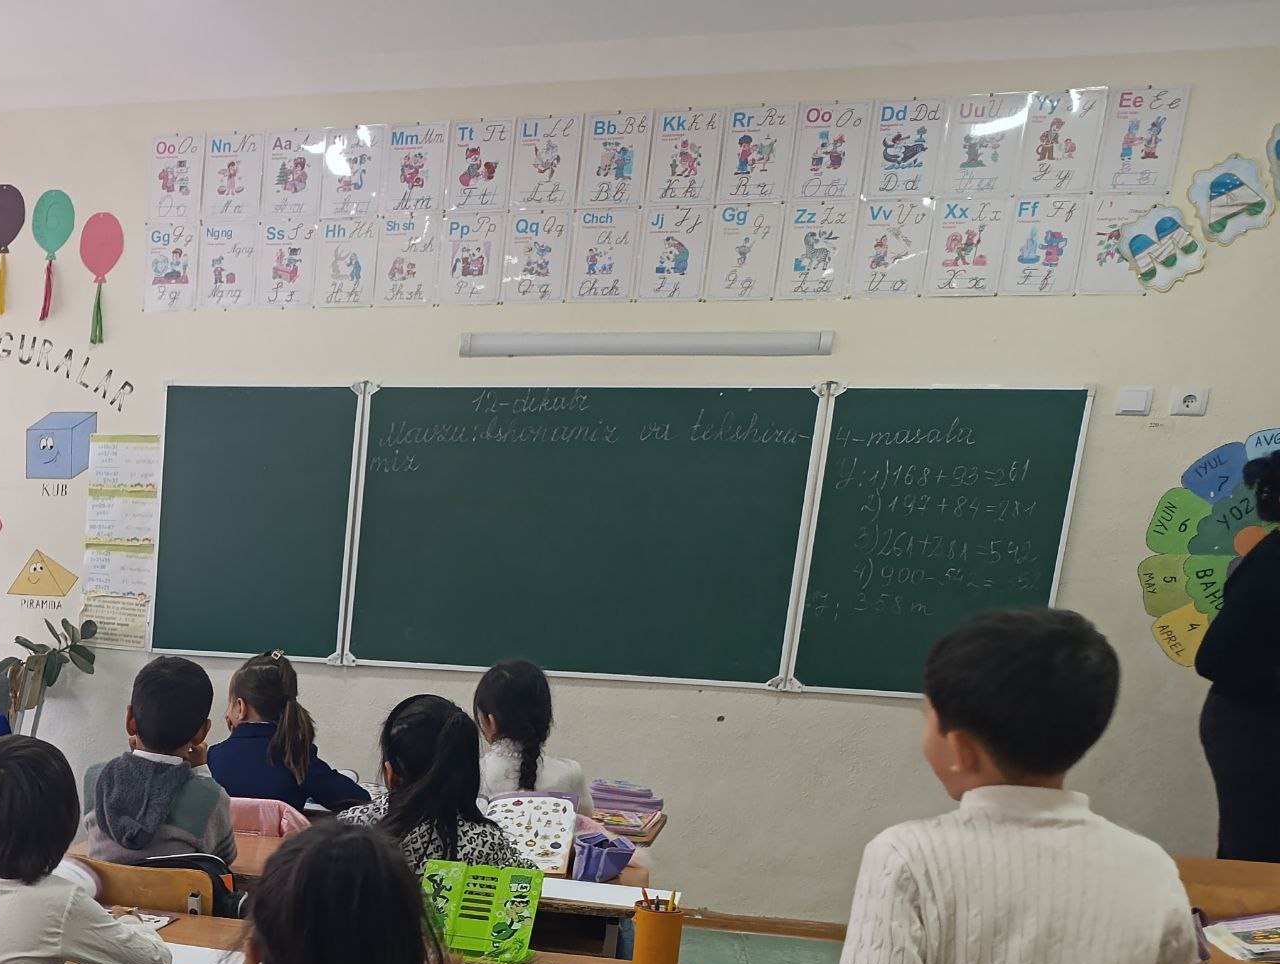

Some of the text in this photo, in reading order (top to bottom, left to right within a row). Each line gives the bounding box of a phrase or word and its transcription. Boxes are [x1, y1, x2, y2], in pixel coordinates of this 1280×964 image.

[1119, 91, 1144, 110] Ee
[732, 112, 753, 128] Rr
[880, 105, 907, 122] Dd
[594, 120, 617, 136] Bb
[663, 116, 687, 132] Kk
[391, 131, 419, 146] Mm
[458, 126, 475, 141] Tt
[156, 141, 176, 155] Oo
[211, 139, 232, 154] Nn
[272, 136, 293, 151] Aa
[794, 208, 817, 225] Zz
[869, 206, 893, 222] Vv
[944, 203, 969, 220] Xx
[1017, 201, 1040, 218] Ff
[449, 221, 470, 238] Pp
[515, 219, 540, 237] Qq
[651, 213, 665, 230] Jj
[151, 230, 170, 246] Gg
[266, 226, 285, 241] Ss
[325, 224, 347, 239] Hh
[1194, 456, 1228, 479] IYUL
[41, 483, 68, 497] KUB
[1153, 500, 1178, 536] IYUN
[1217, 497, 1255, 530] YOZ
[1177, 517, 1191, 533] 6
[1143, 571, 1157, 595] MAY
[1163, 575, 1177, 584] 5
[20, 598, 64, 611] PIRAMIDA
[1186, 622, 1201, 633] 4
[1157, 623, 1185, 657] APREL
